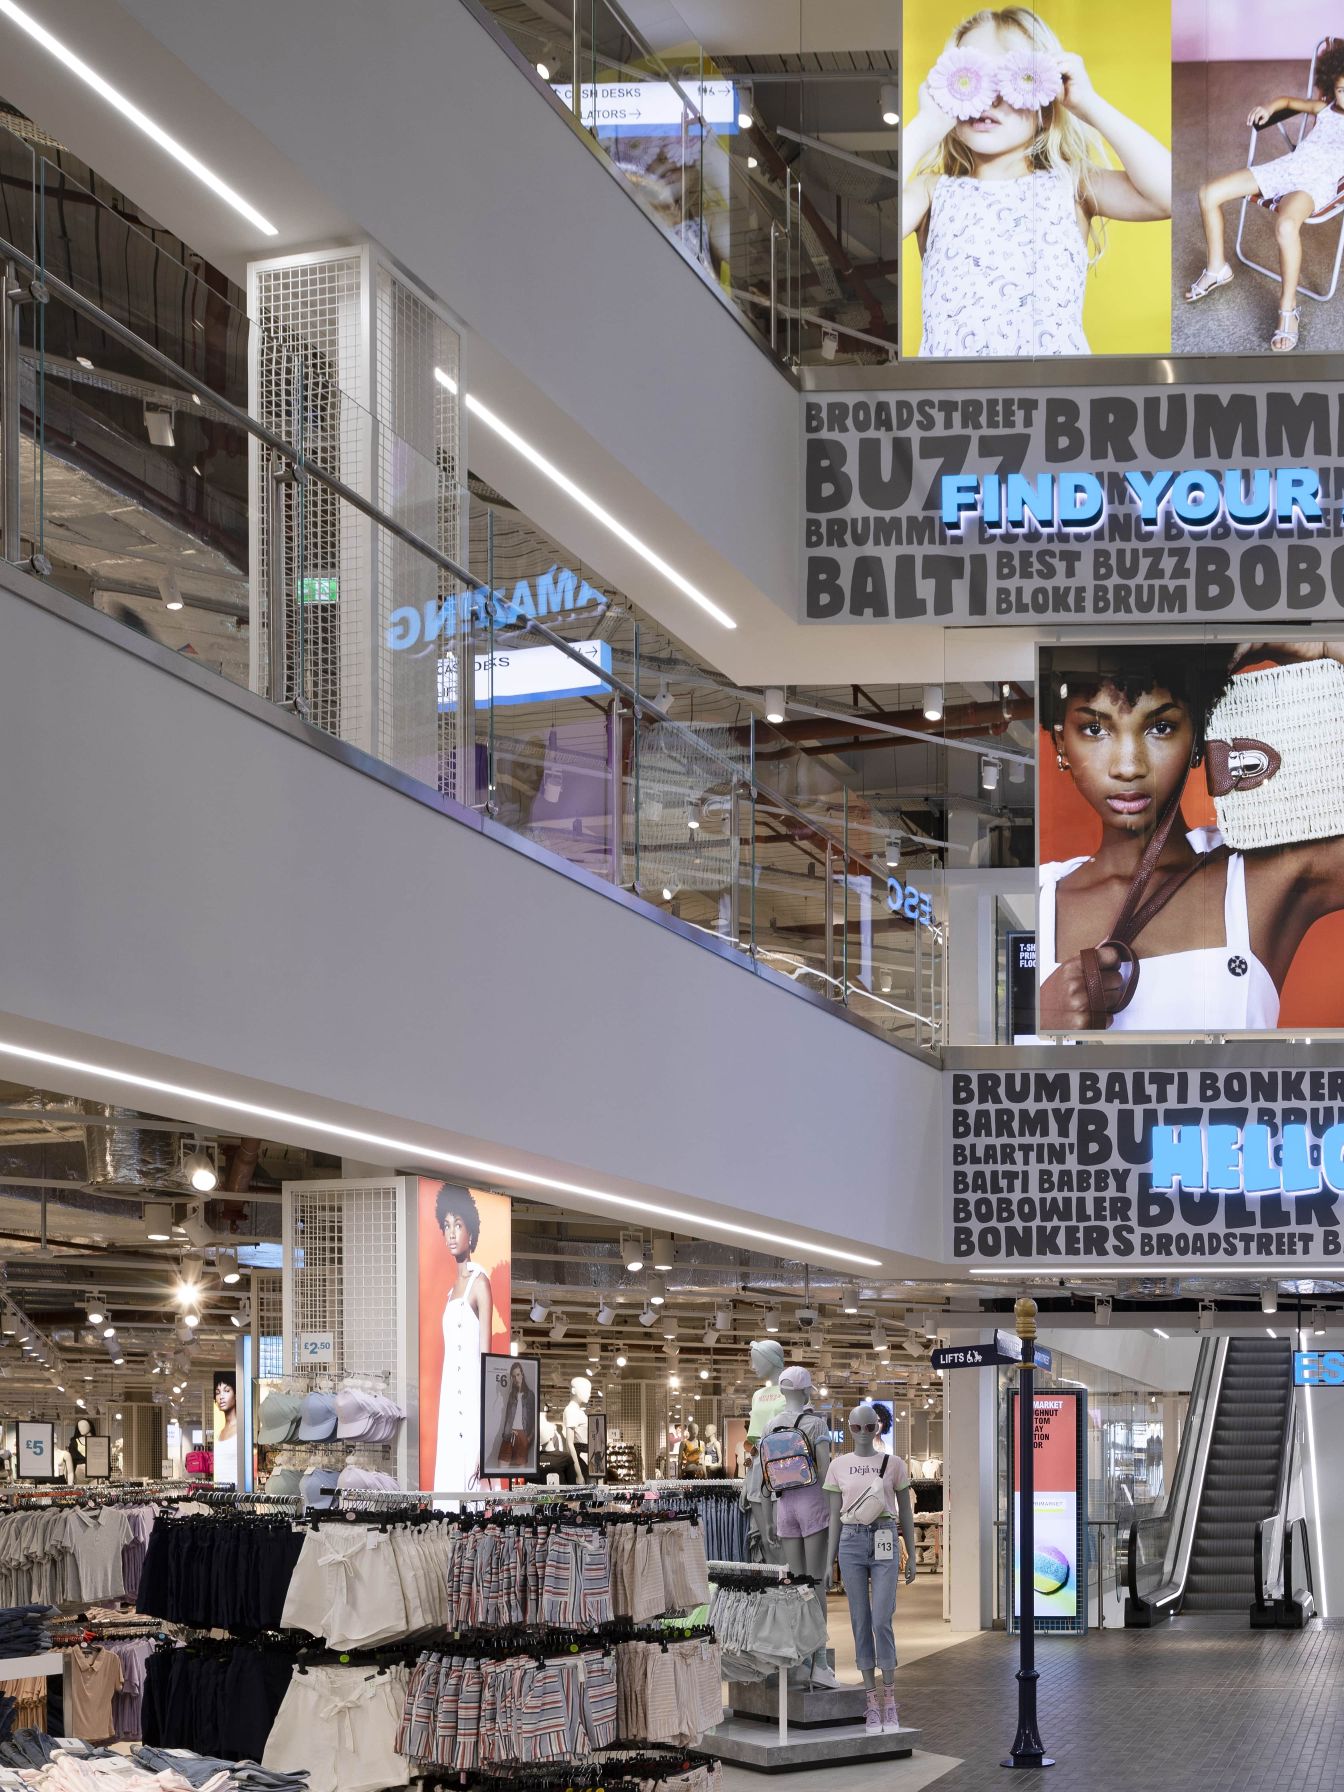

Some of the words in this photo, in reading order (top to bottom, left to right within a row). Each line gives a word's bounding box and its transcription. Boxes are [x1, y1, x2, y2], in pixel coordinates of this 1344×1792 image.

[602, 87, 641, 98] DESKS
[805, 398, 1038, 434] BROADSTREET
[941, 472, 1106, 527] FIND
[1124, 467, 1322, 527] YOUR
[806, 553, 988, 619] BALTI
[996, 549, 1082, 581] BEST
[1093, 546, 1191, 581] BUZZ
[996, 586, 1087, 615] BLOKE
[1093, 584, 1188, 614] BRUM
[1019, 943, 1035, 952] T-SH
[952, 1072, 1072, 1105] BRUM
[1079, 1071, 1189, 1105] BALTI
[952, 1107, 1075, 1139] BARMY
[952, 1142, 1075, 1167] BLARTIN'
[953, 1169, 1029, 1195] BALTI
[1038, 1168, 1132, 1194] BABBY
[953, 1196, 1132, 1224] BOBOWLER
[953, 1223, 1135, 1258] BONKERS
[1140, 1231, 1314, 1257] BROADSTREET
[304, 1342, 330, 1355] £2.50
[940, 1353, 965, 1364] LIFTS
[495, 1374, 508, 1388] £6
[25, 1439, 44, 1456] £5
[877, 1542, 892, 1552] £13
